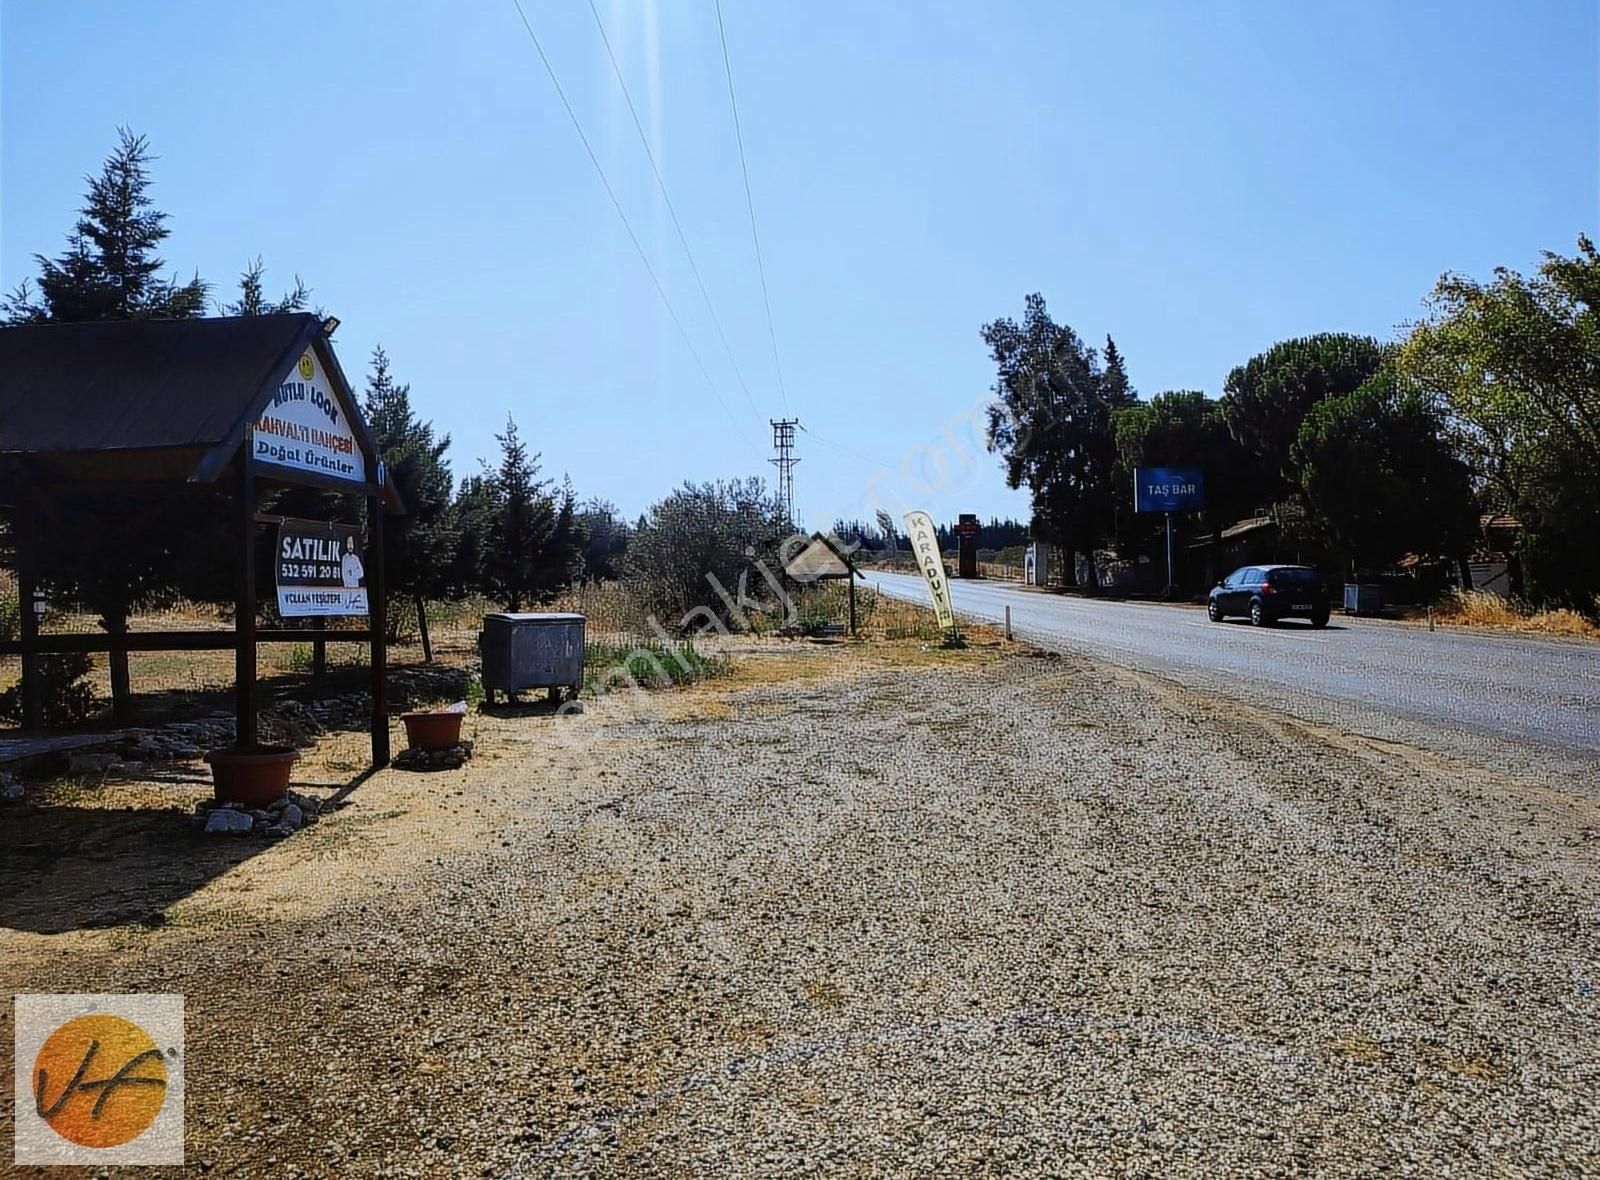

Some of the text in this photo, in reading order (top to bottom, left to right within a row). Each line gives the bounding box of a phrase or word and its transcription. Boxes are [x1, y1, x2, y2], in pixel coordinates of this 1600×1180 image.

[310, 386, 339, 425] LOOK
[257, 440, 354, 474] Doğal Ürünler
[1148, 484, 1195, 497] TAŞ BAR
[281, 536, 341, 561] SATILIK
[911, 518, 944, 602] KARADUT
[281, 563, 300, 578] 532
[301, 564, 317, 578] 591
[319, 565, 331, 578] 20
